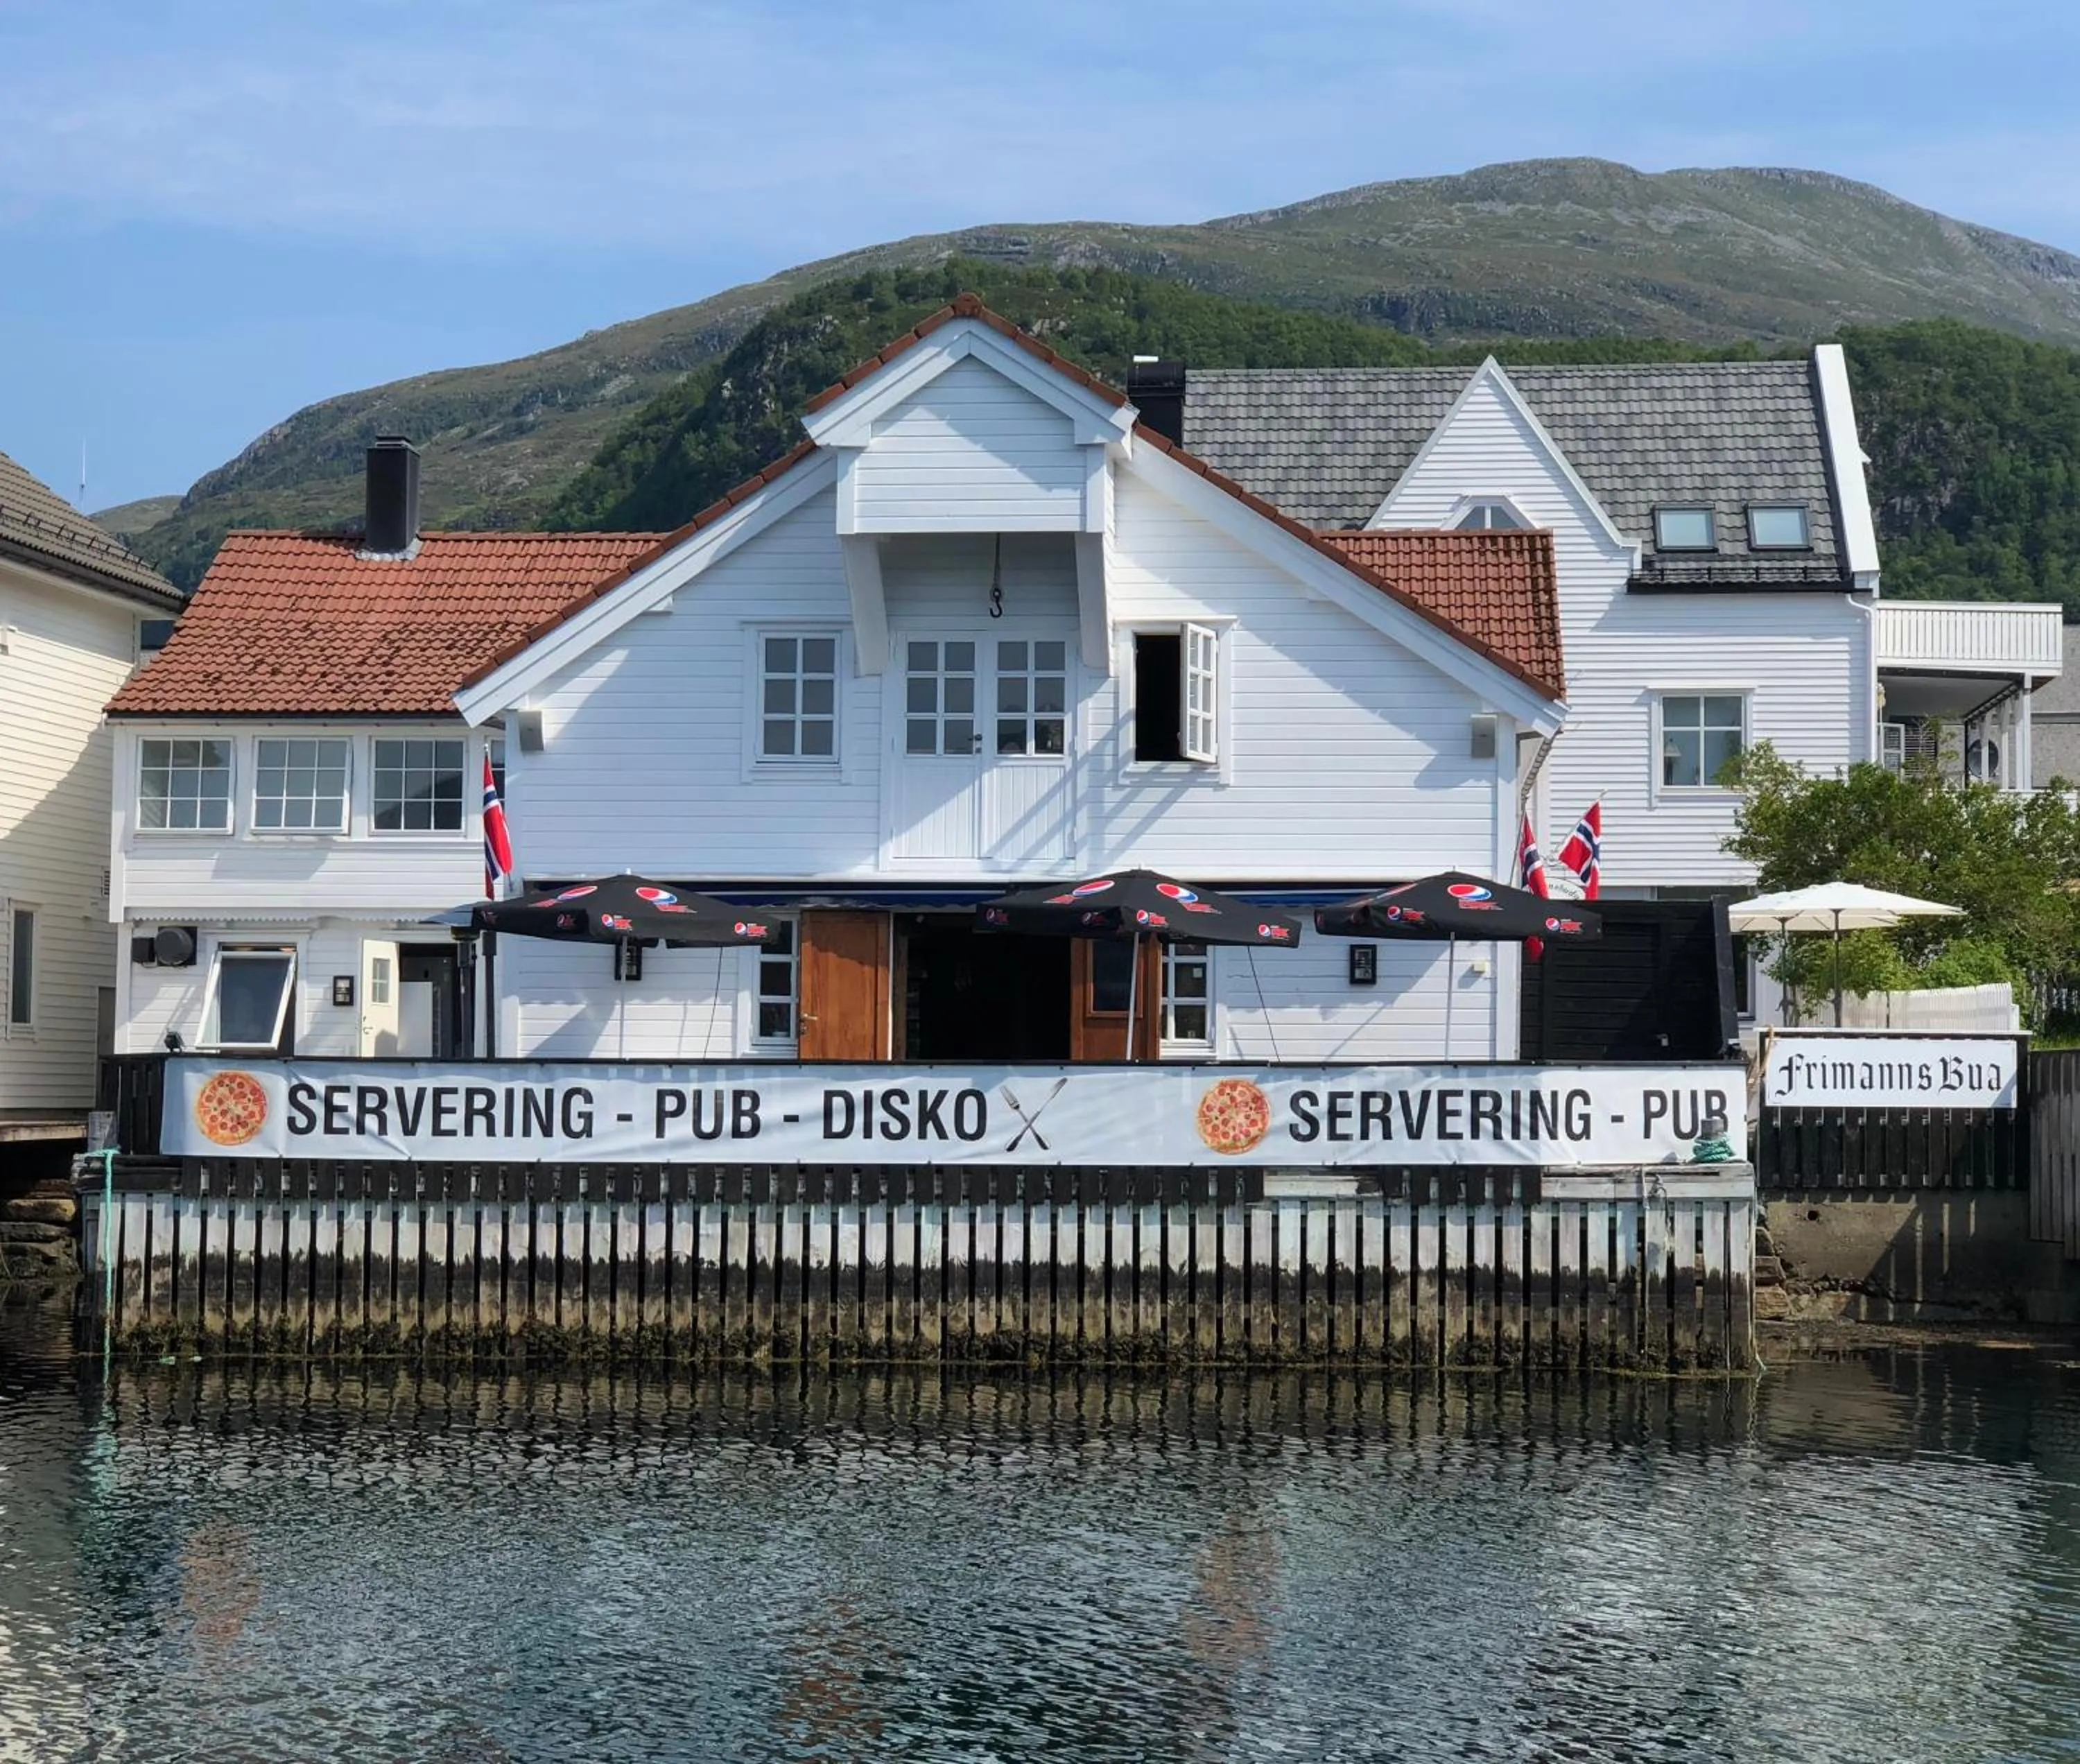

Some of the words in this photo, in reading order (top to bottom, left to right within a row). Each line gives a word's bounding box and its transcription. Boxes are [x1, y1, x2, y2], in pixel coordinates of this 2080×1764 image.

[287, 1082, 594, 1139] SERVERING
[655, 1089, 761, 1141] PUB
[823, 1088, 987, 1141] DISKO
[1288, 1089, 1592, 1142] SERVERING
[1643, 1089, 1728, 1141] PUB
